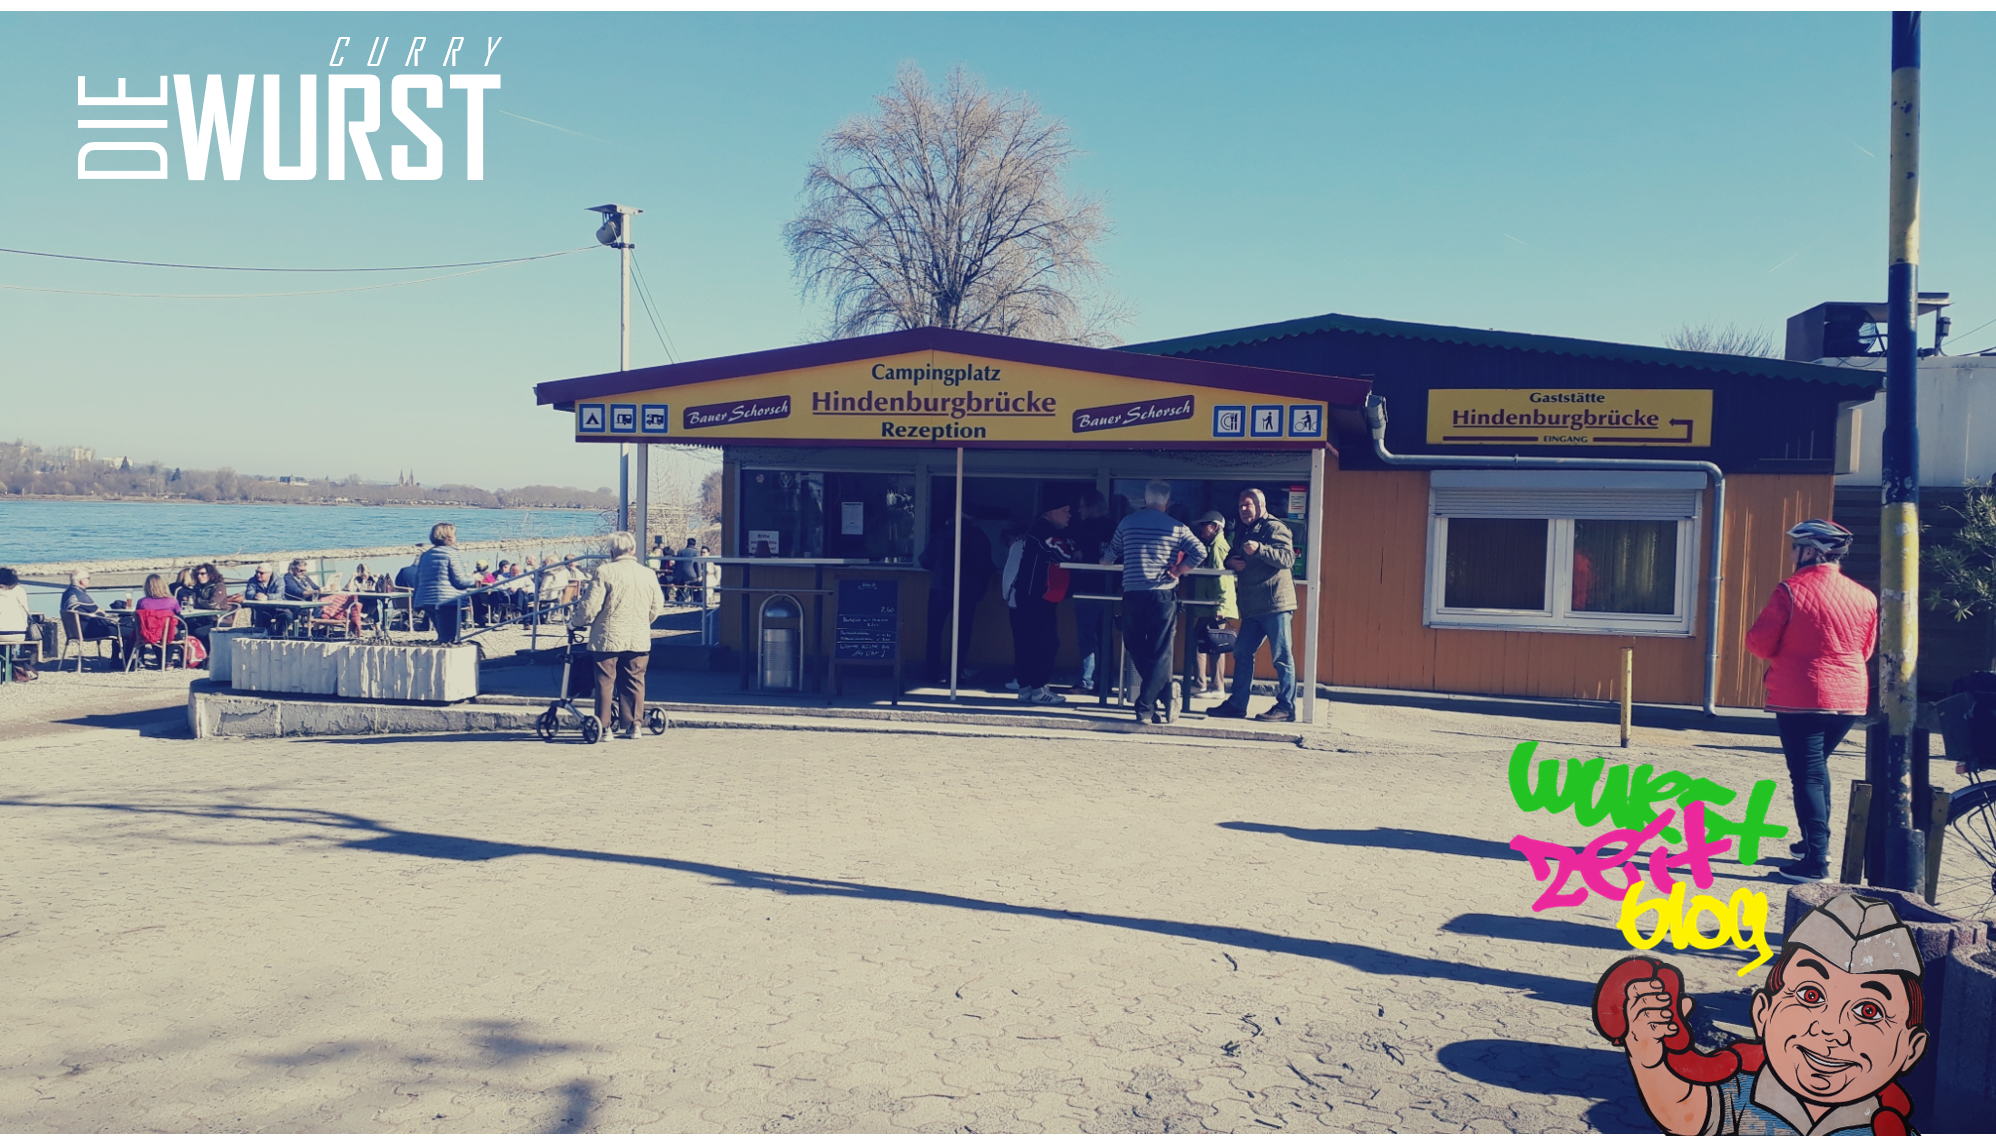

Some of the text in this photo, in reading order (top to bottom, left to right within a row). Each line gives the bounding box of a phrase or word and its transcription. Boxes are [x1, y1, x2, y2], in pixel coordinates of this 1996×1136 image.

[871, 363, 1001, 386] Campingplatz
[812, 390, 1057, 419] Hindenburgbrücke
[1529, 392, 1605, 403] Gaststätte
[687, 400, 788, 424] Bauer Schorsch
[1076, 400, 1190, 428] Bauer Schorsch
[1452, 409, 1659, 430] Hindenburgbrücke
[881, 421, 986, 443] Rezeption
[1543, 435, 1588, 443] EINGANG
